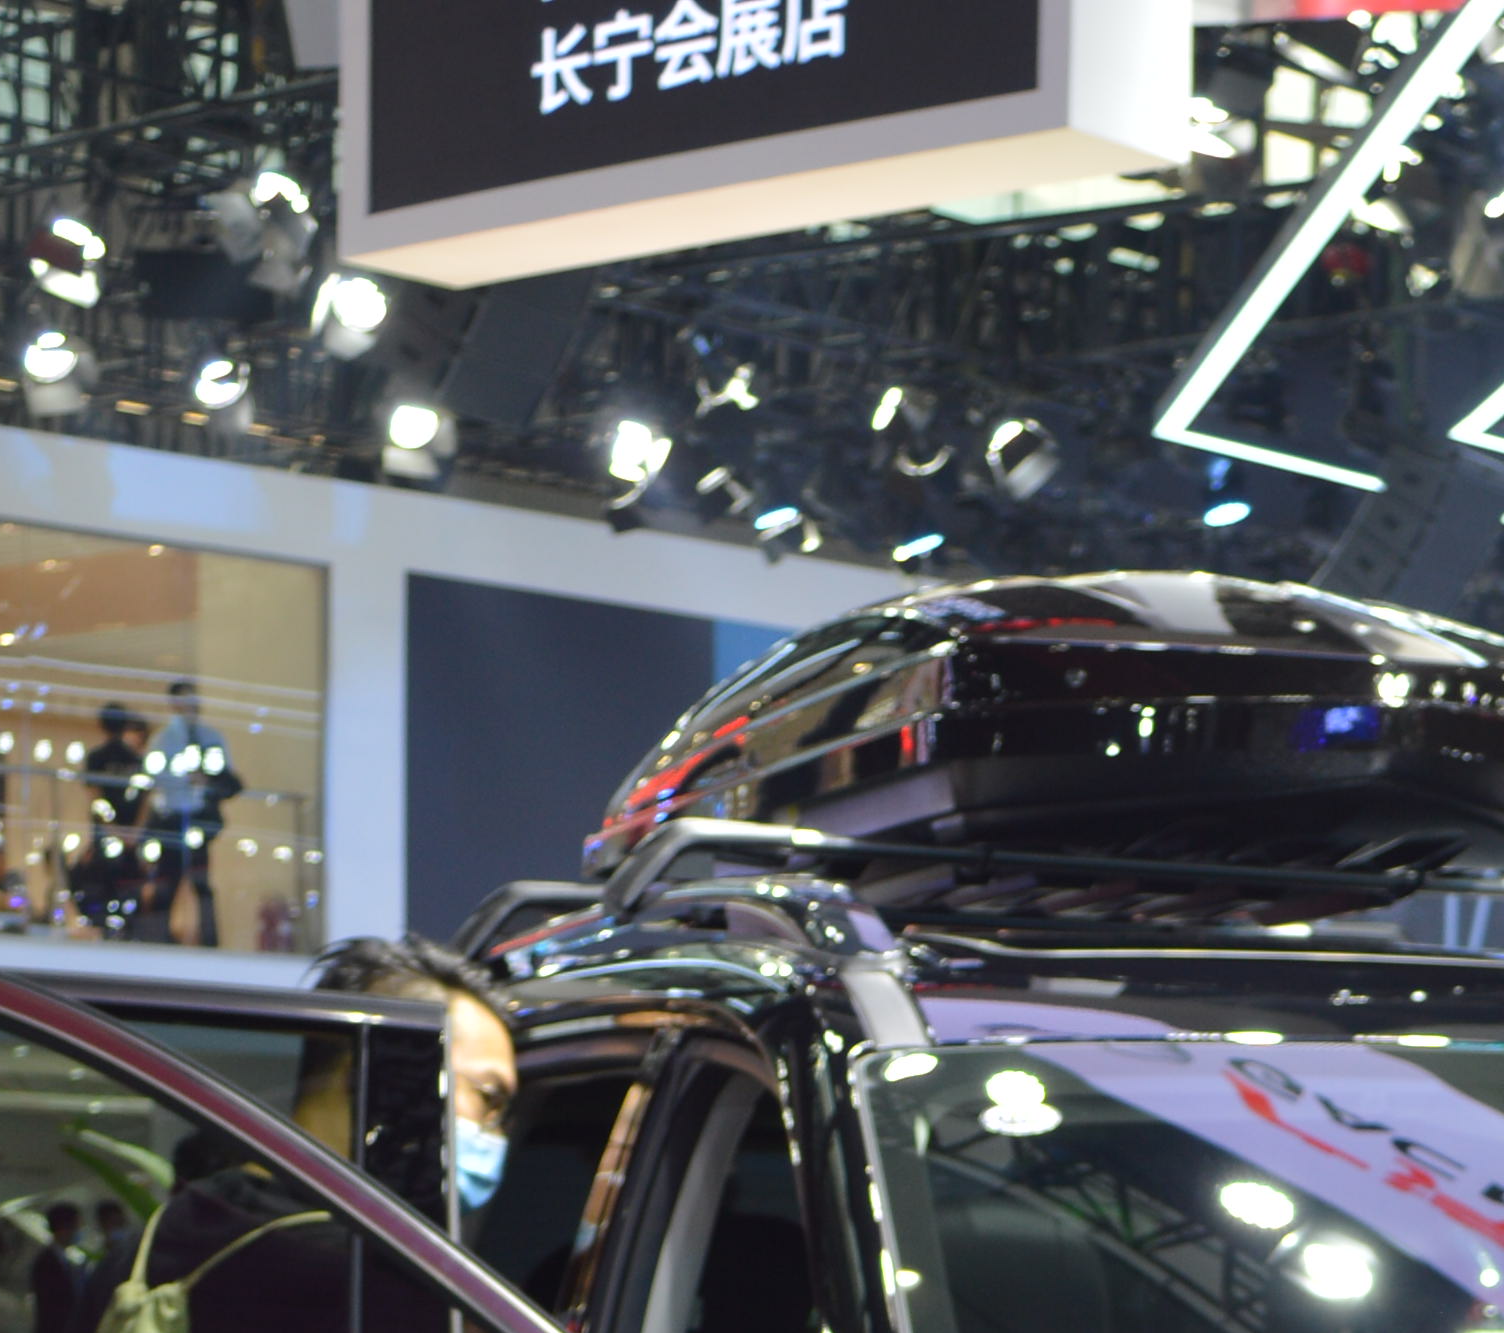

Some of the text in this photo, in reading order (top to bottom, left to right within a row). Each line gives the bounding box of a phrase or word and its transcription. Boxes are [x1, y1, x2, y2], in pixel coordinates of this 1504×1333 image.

[530, 0, 848, 116] 长宁会展店
